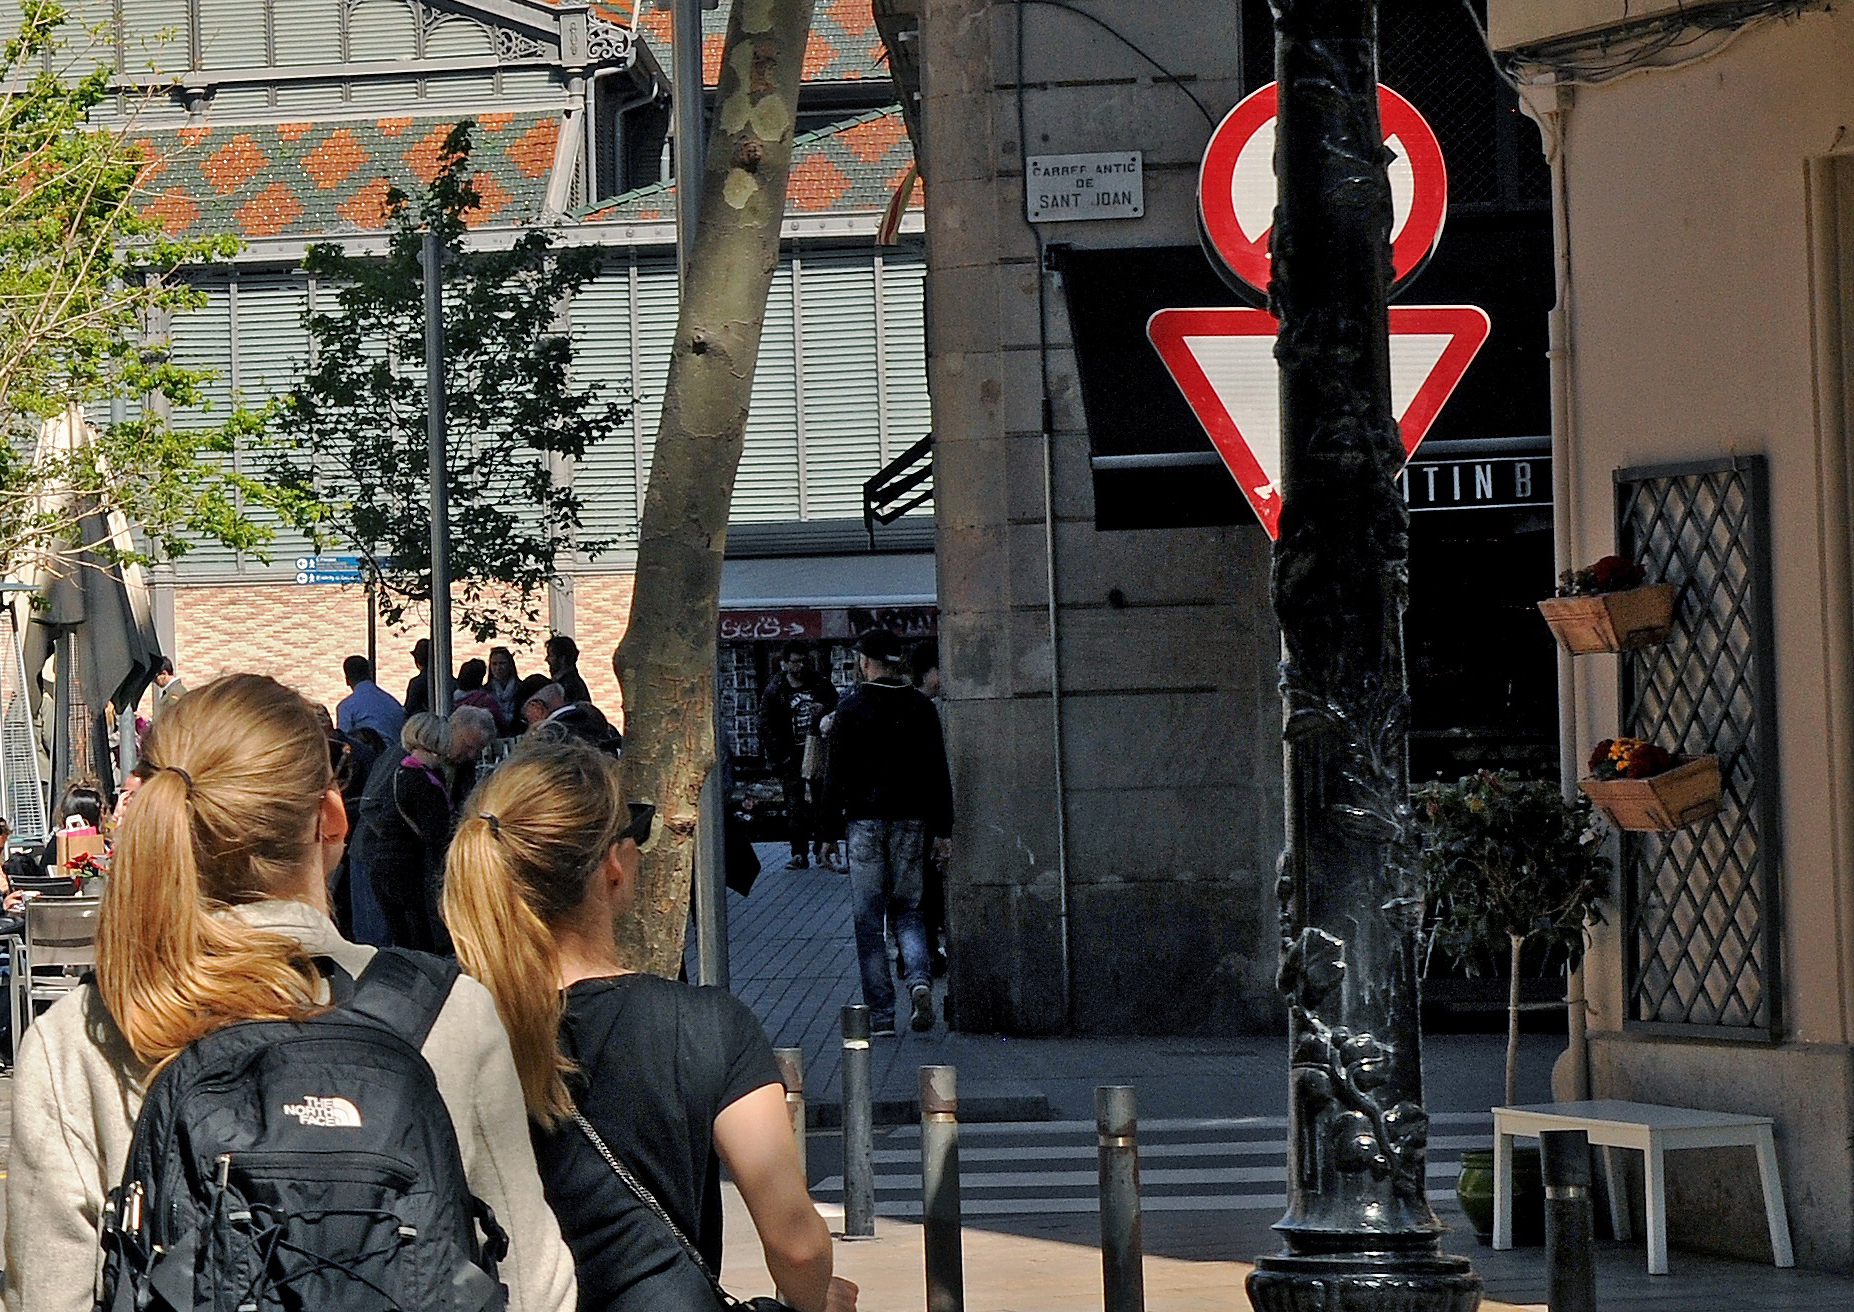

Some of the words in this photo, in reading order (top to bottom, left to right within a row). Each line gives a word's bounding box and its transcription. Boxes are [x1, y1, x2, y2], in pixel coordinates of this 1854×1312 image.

[1096, 163, 1136, 174] ANTIC
[1076, 178, 1094, 188] DE
[1040, 193, 1081, 209] SANT
[1091, 191, 1132, 207] JOAN
[1402, 464, 1493, 504] ITIN
[1514, 462, 1532, 498] B
[303, 1095, 334, 1108] THE
[283, 1104, 333, 1118] NORTH
[299, 1115, 336, 1127] FACE
